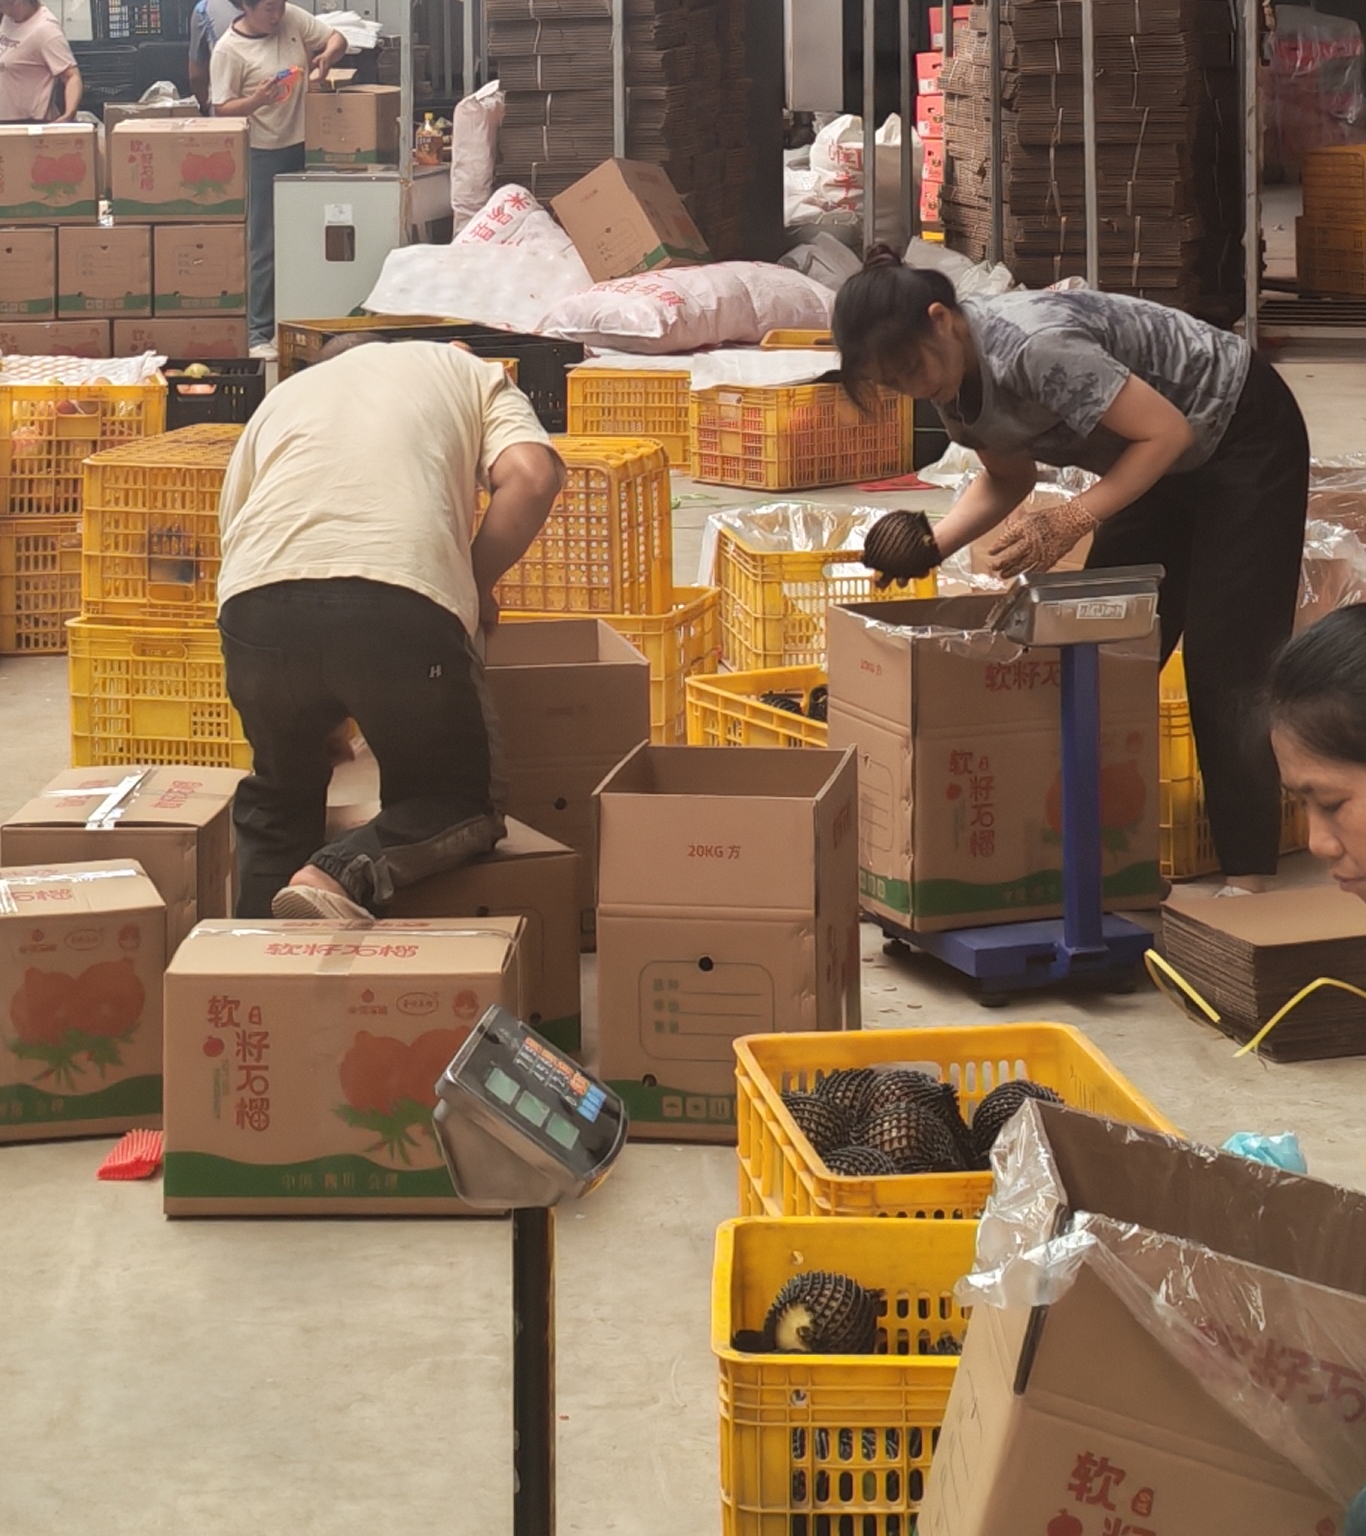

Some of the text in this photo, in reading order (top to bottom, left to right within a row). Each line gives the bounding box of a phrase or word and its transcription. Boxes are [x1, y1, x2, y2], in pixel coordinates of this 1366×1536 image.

[949, 749, 995, 858] 软籽石榴
[688, 845, 723, 858] 20KG
[265, 942, 419, 958] 软籽石榴
[207, 994, 271, 1132] 软籽石榴
